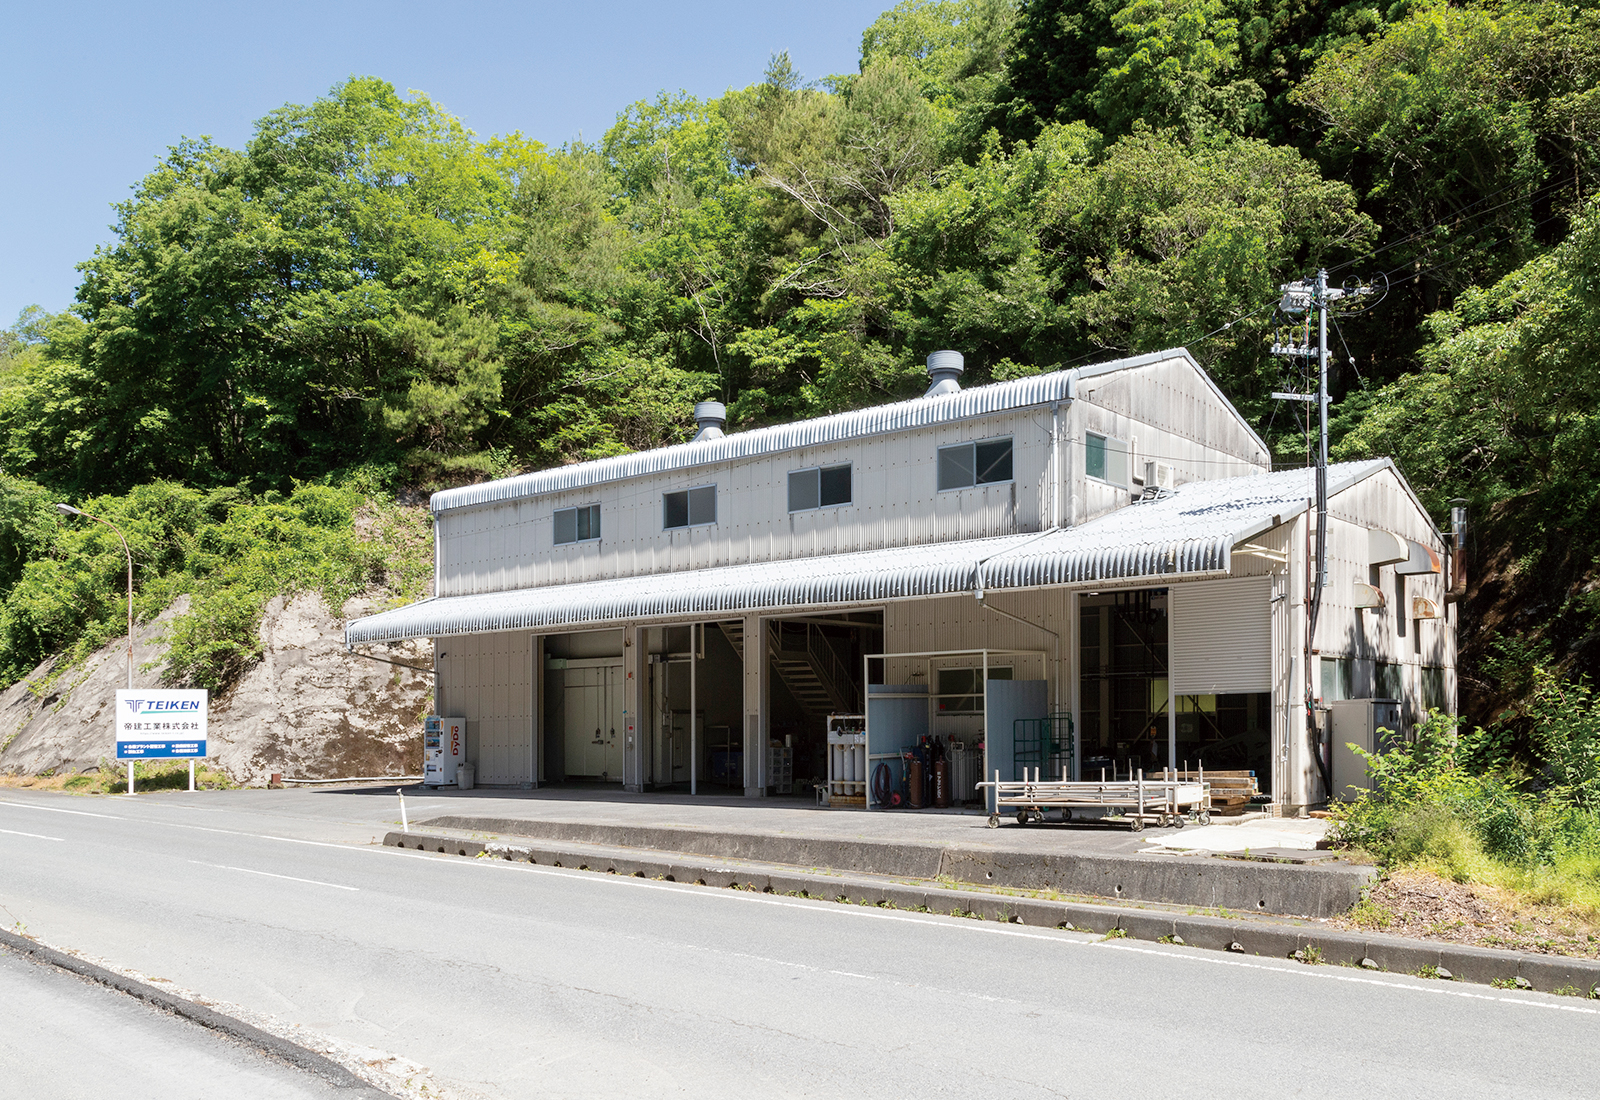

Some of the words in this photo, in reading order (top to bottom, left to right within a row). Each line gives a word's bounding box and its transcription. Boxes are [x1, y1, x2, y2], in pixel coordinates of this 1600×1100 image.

[147, 701, 200, 710] TEIKEN
[124, 722, 199, 731] 帝建工業株式会社
